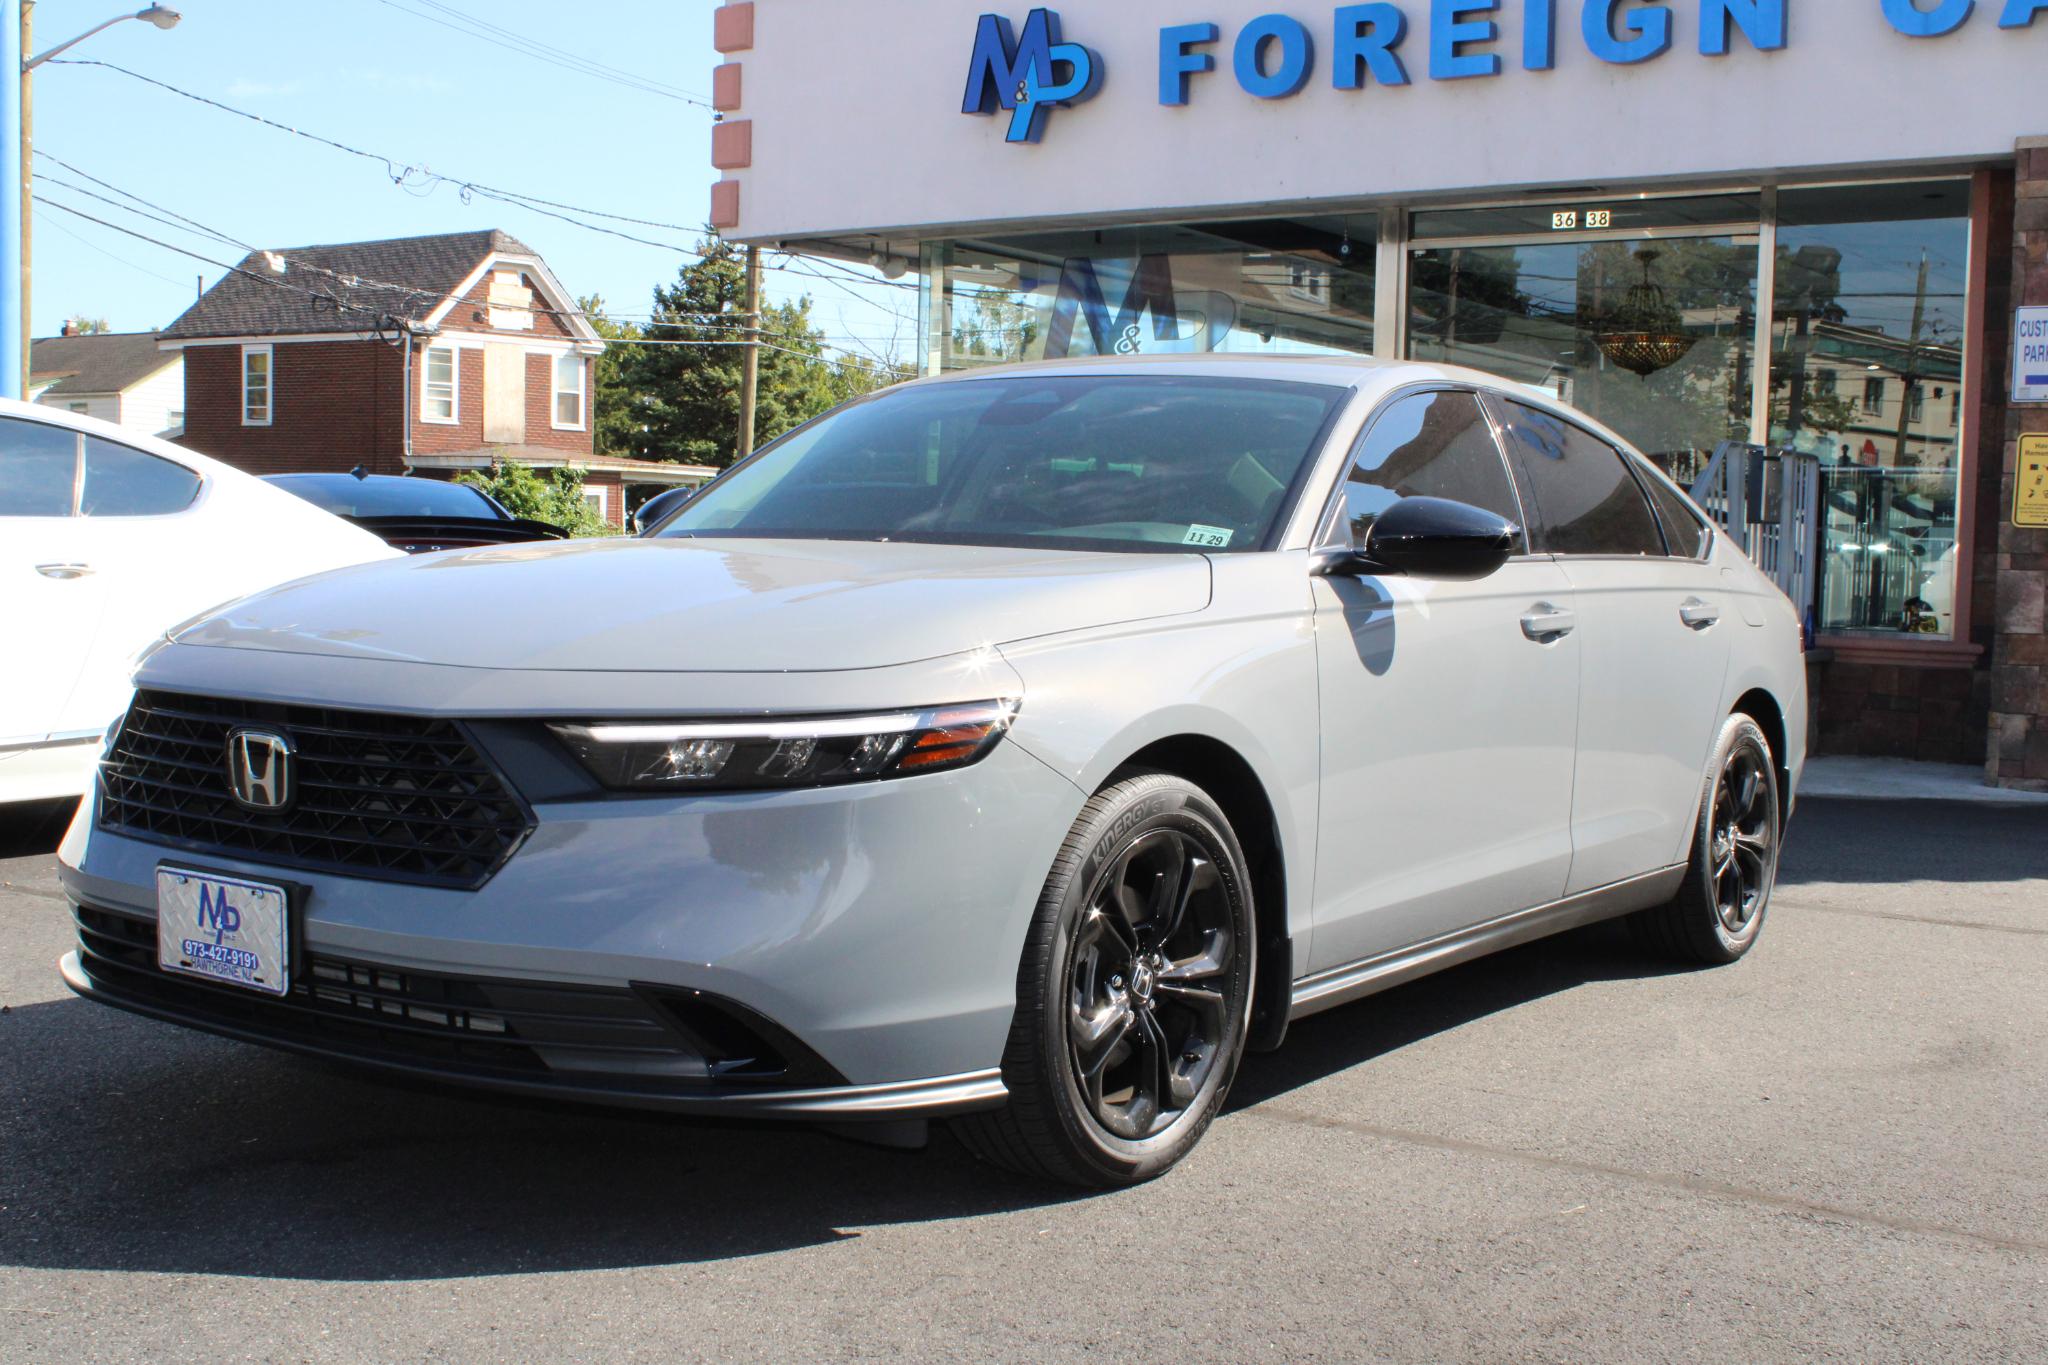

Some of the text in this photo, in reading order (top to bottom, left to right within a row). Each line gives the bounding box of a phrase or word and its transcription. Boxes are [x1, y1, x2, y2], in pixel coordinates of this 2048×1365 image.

[1158, 0, 1787, 106] FOREIGN
[1554, 212, 1608, 227] 36 38
[2023, 345, 2048, 362] PAR
[1189, 532, 1223, 546] 11 29
[1092, 799, 1150, 869] KINERGY
[184, 940, 257, 970] 973-427-9191
